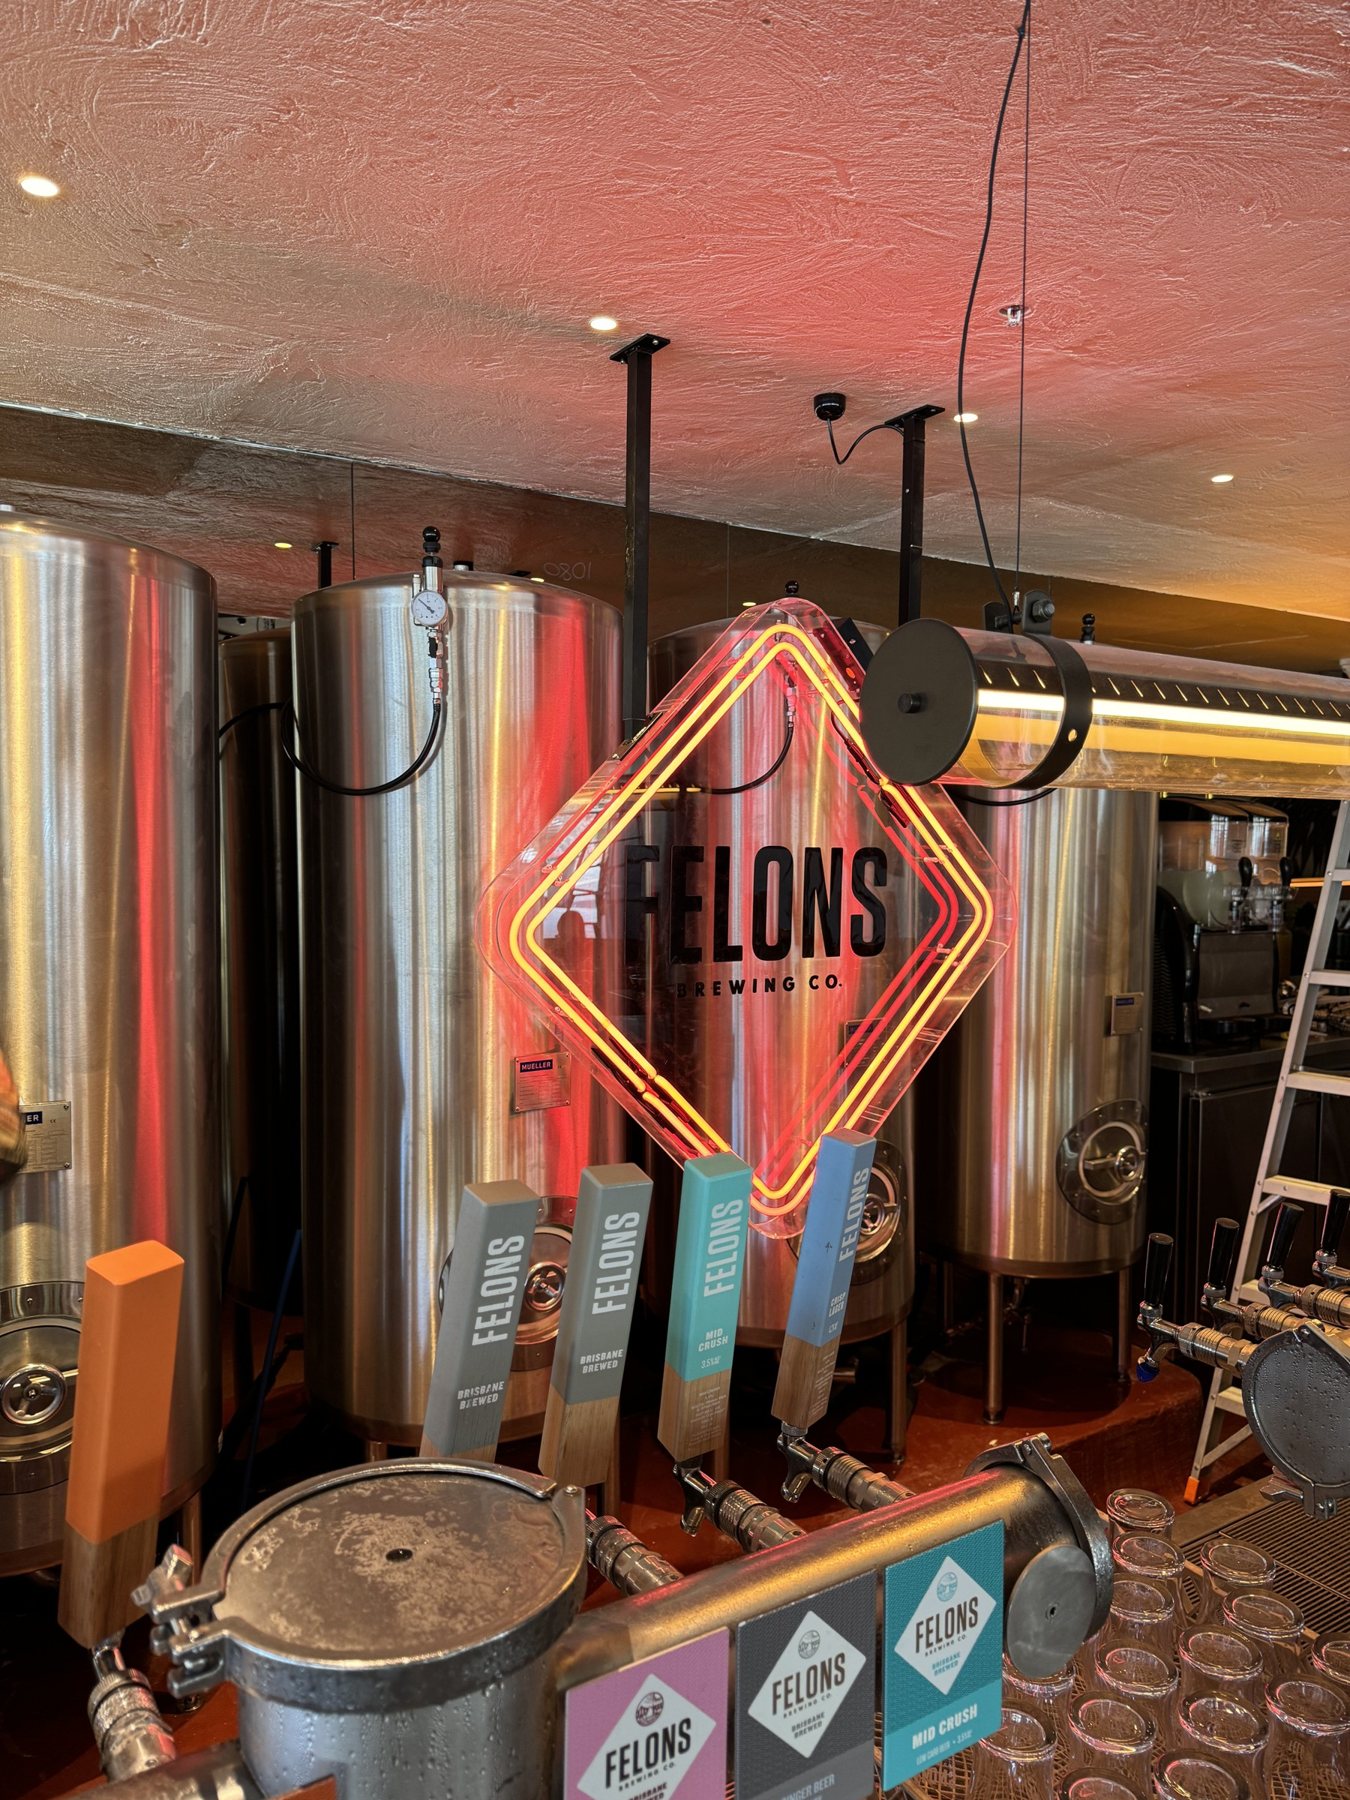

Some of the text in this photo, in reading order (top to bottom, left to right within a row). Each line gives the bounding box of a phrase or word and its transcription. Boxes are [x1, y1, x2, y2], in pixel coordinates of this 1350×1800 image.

[623, 845, 888, 965] FELONS
[676, 973, 843, 999] BREWING CO.
[521, 1061, 552, 1072] MUELLER
[839, 1166, 870, 1263] FELONS
[704, 1197, 744, 1299] FELONS
[591, 1210, 641, 1316] FELONS
[471, 1233, 526, 1347] FELONS
[698, 1335, 729, 1352] CRUSH
[705, 1327, 724, 1341] MID
[580, 1348, 624, 1365] BRISBANE
[582, 1359, 619, 1374] BREWED
[457, 1380, 505, 1400] BRISBANE
[914, 1595, 980, 1655] FELONS
[924, 1639, 956, 1658] BREWING
[931, 1651, 961, 1671] BRISBANE
[934, 1660, 959, 1677] BREWED
[771, 1651, 846, 1716] FELONS
[783, 1700, 818, 1719] BREWING
[791, 1711, 825, 1732] BRISBANE
[793, 1720, 823, 1739] BREWED
[912, 1703, 978, 1750] MID CRUSH
[605, 1717, 692, 1789] FELONS
[618, 1769, 660, 1793] BREWING
[813, 1773, 836, 1794] BEER
